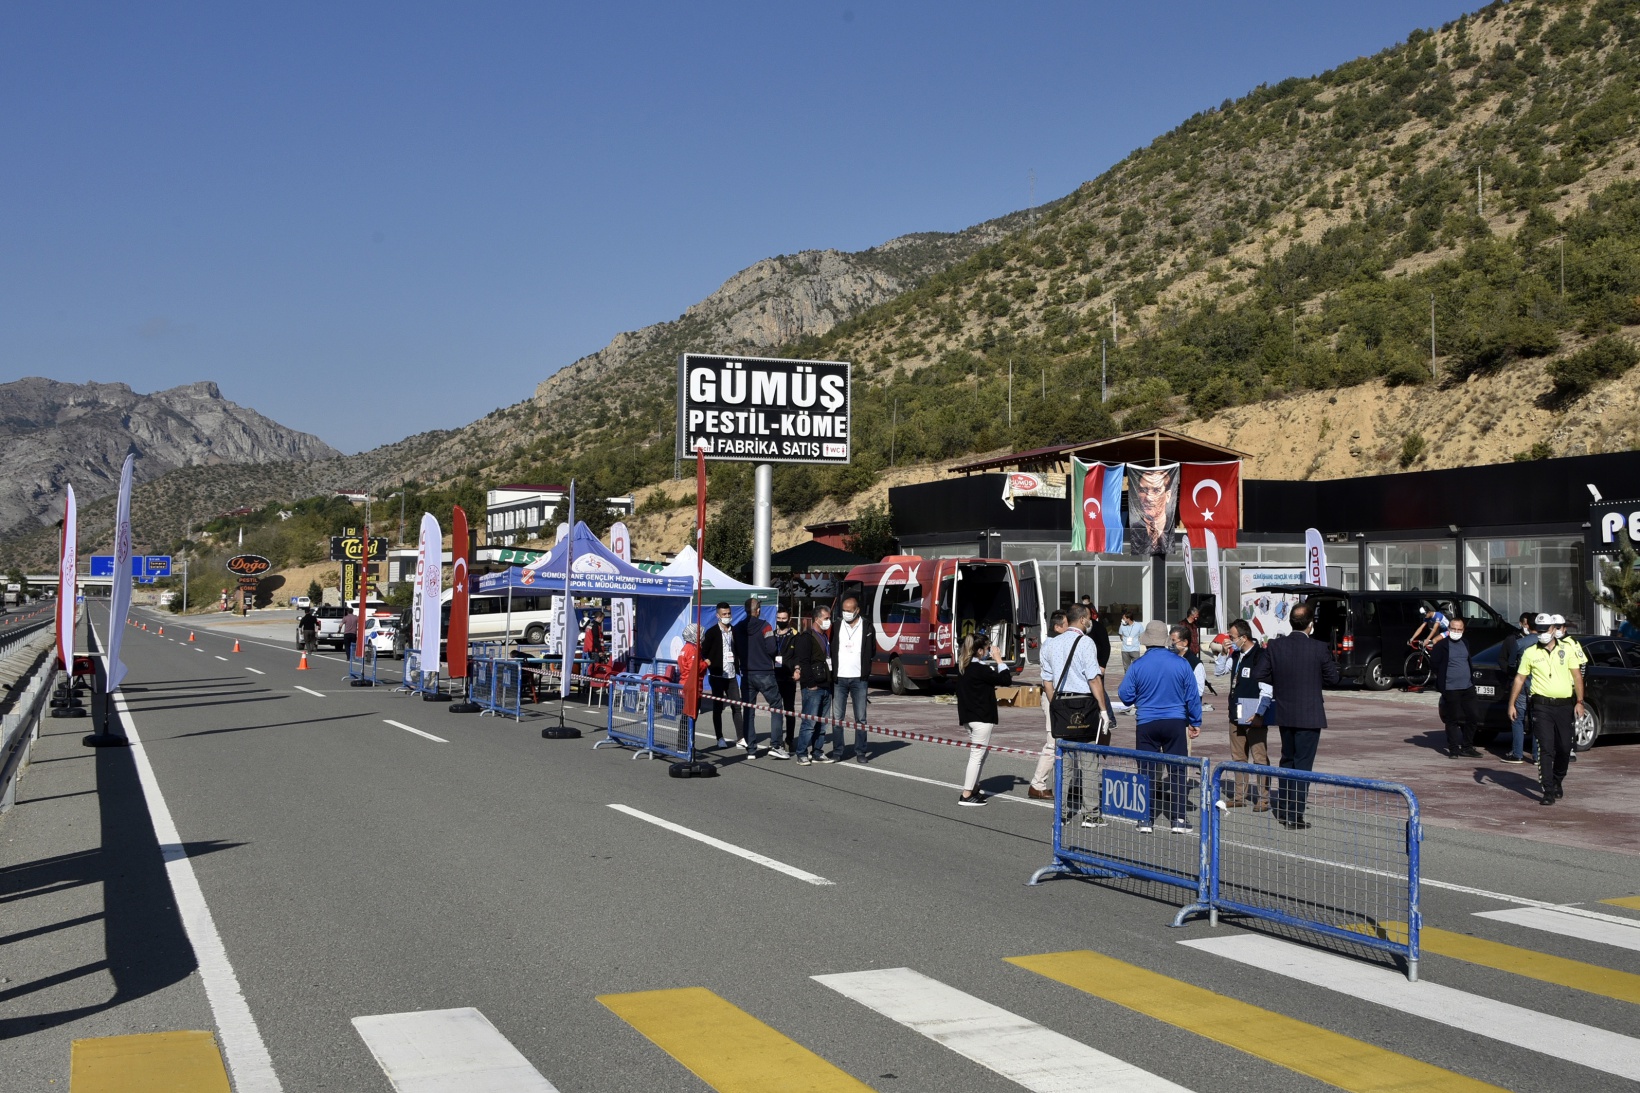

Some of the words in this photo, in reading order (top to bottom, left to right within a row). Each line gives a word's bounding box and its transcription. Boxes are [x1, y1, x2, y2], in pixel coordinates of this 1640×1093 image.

[689, 361, 845, 413] GÜMÜŞ
[688, 408, 847, 438] PESTİL-KÖME
[717, 437, 779, 455] FABRİKA
[782, 441, 820, 457] SATIŞ
[341, 538, 378, 559] Tatil
[230, 557, 268, 573] Doğa
[541, 571, 585, 580] GÜMÜŞANE
[586, 573, 614, 582] GENÇLİK
[615, 574, 654, 584] HİZMETLERİ
[587, 580, 594, 588] İL
[594, 581, 637, 591] MÜDÜRLÜĞÜ
[1104, 775, 1147, 813] POLİS
